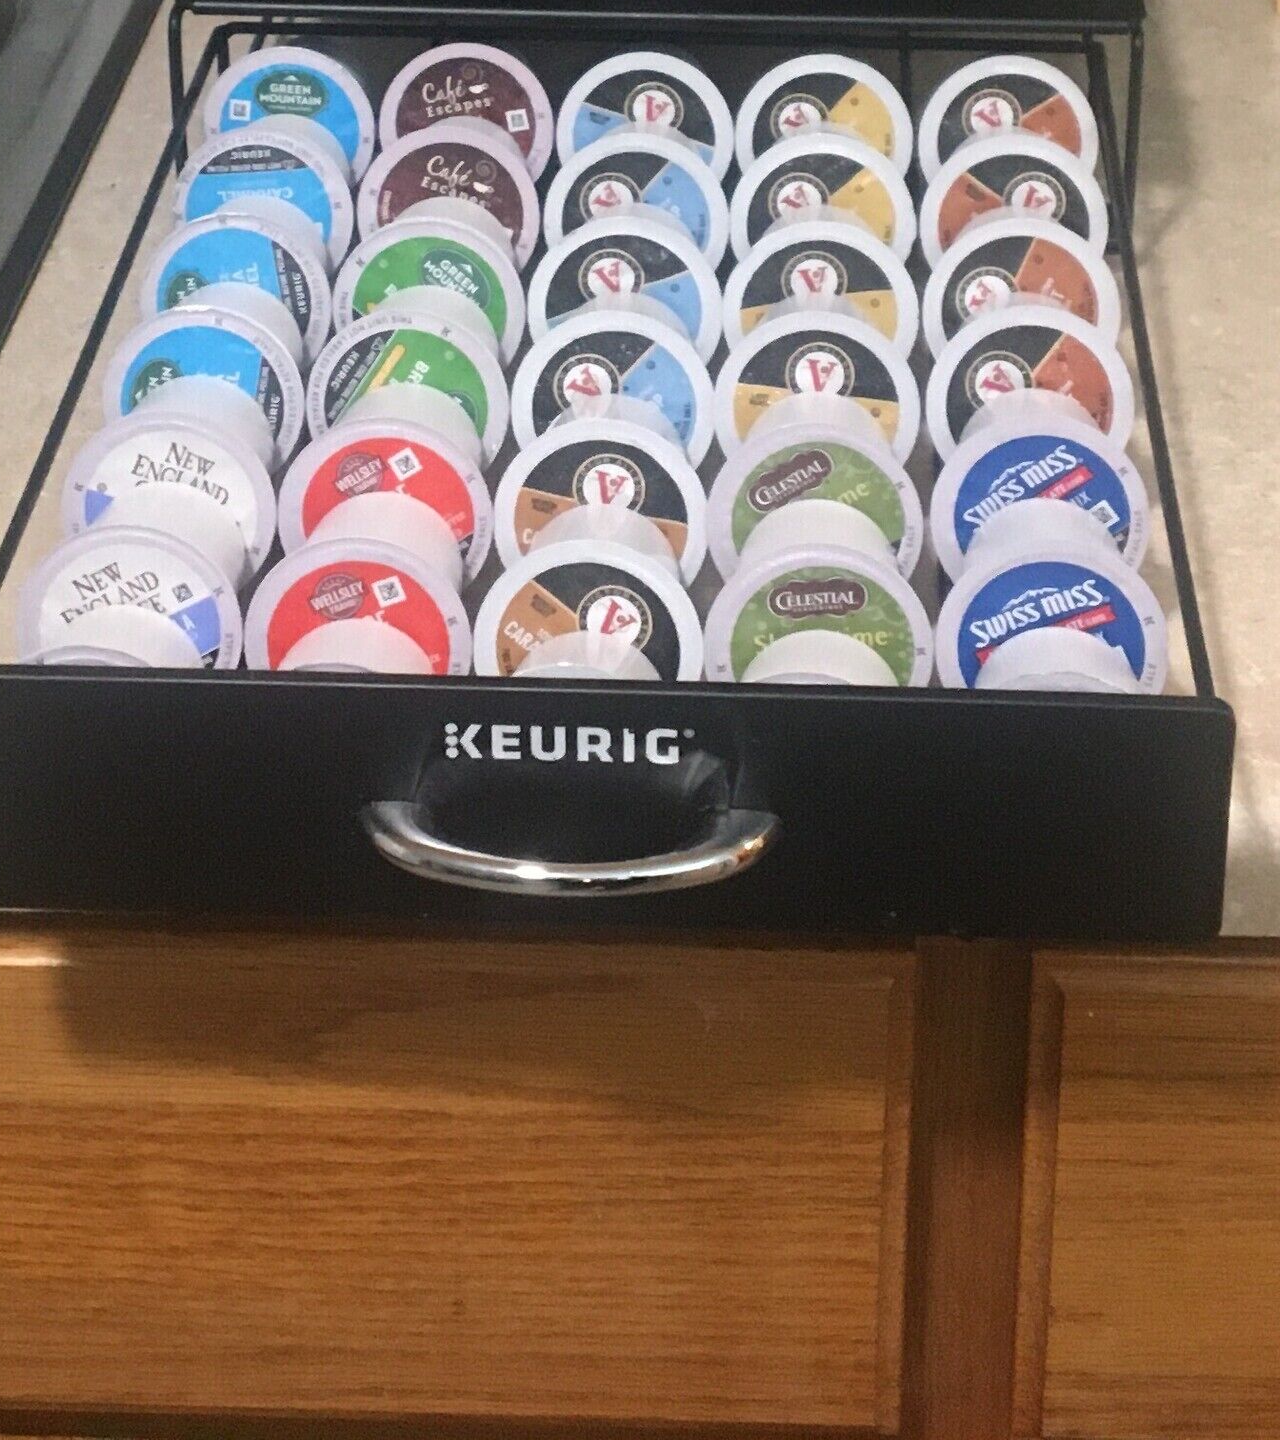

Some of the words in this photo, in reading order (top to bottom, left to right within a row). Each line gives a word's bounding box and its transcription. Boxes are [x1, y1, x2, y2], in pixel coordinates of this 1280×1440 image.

[259, 93, 322, 106] MOUNTAIN
[269, 82, 312, 95] GREEN
[422, 76, 466, 105] Café
[426, 97, 492, 118] Escapes
[230, 149, 271, 160] KEURIG
[426, 155, 472, 186] Café
[290, 272, 308, 315] KEURIG
[440, 260, 478, 294] GREEN
[330, 351, 360, 392] KEURIG
[165, 442, 216, 476] NEW
[755, 459, 824, 505] CELESTIAL
[963, 478, 1025, 526] SWISS
[1020, 445, 1078, 488] MISS
[71, 562, 122, 599] NEW
[775, 591, 855, 610] CELESTIAL
[970, 602, 1041, 648] SWISS
[1040, 579, 1103, 617] MISS
[444, 722, 696, 765] KEURIG
